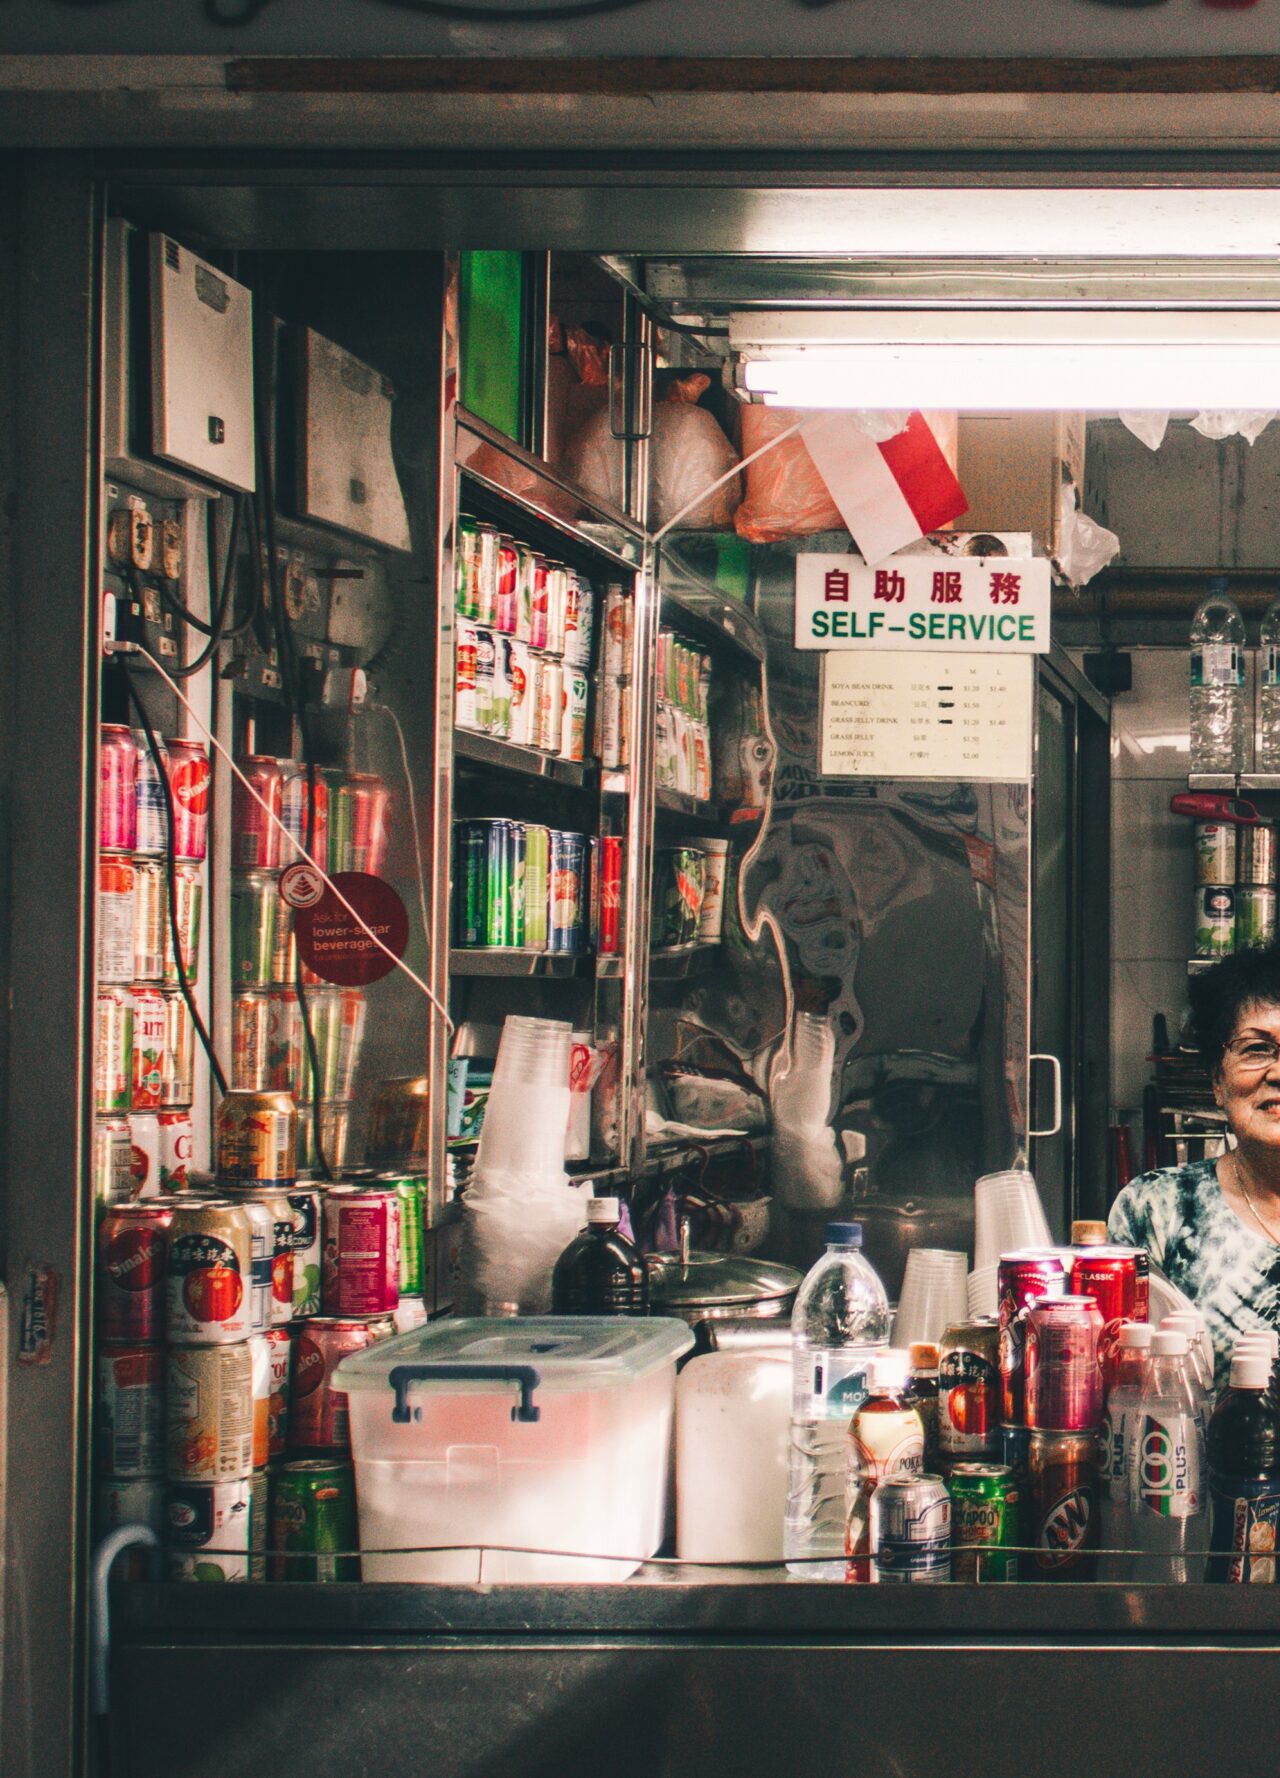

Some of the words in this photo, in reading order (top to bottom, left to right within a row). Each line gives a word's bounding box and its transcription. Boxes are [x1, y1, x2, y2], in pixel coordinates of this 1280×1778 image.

[824, 568, 1022, 605] 自助服務
[811, 610, 1036, 641] SELF-SERVICE
[876, 717, 898, 725] DRINK
[1080, 1271, 1115, 1282] CLASSIC
[1140, 1431, 1174, 1500] 100
[1175, 1445, 1187, 1491] PLUS
